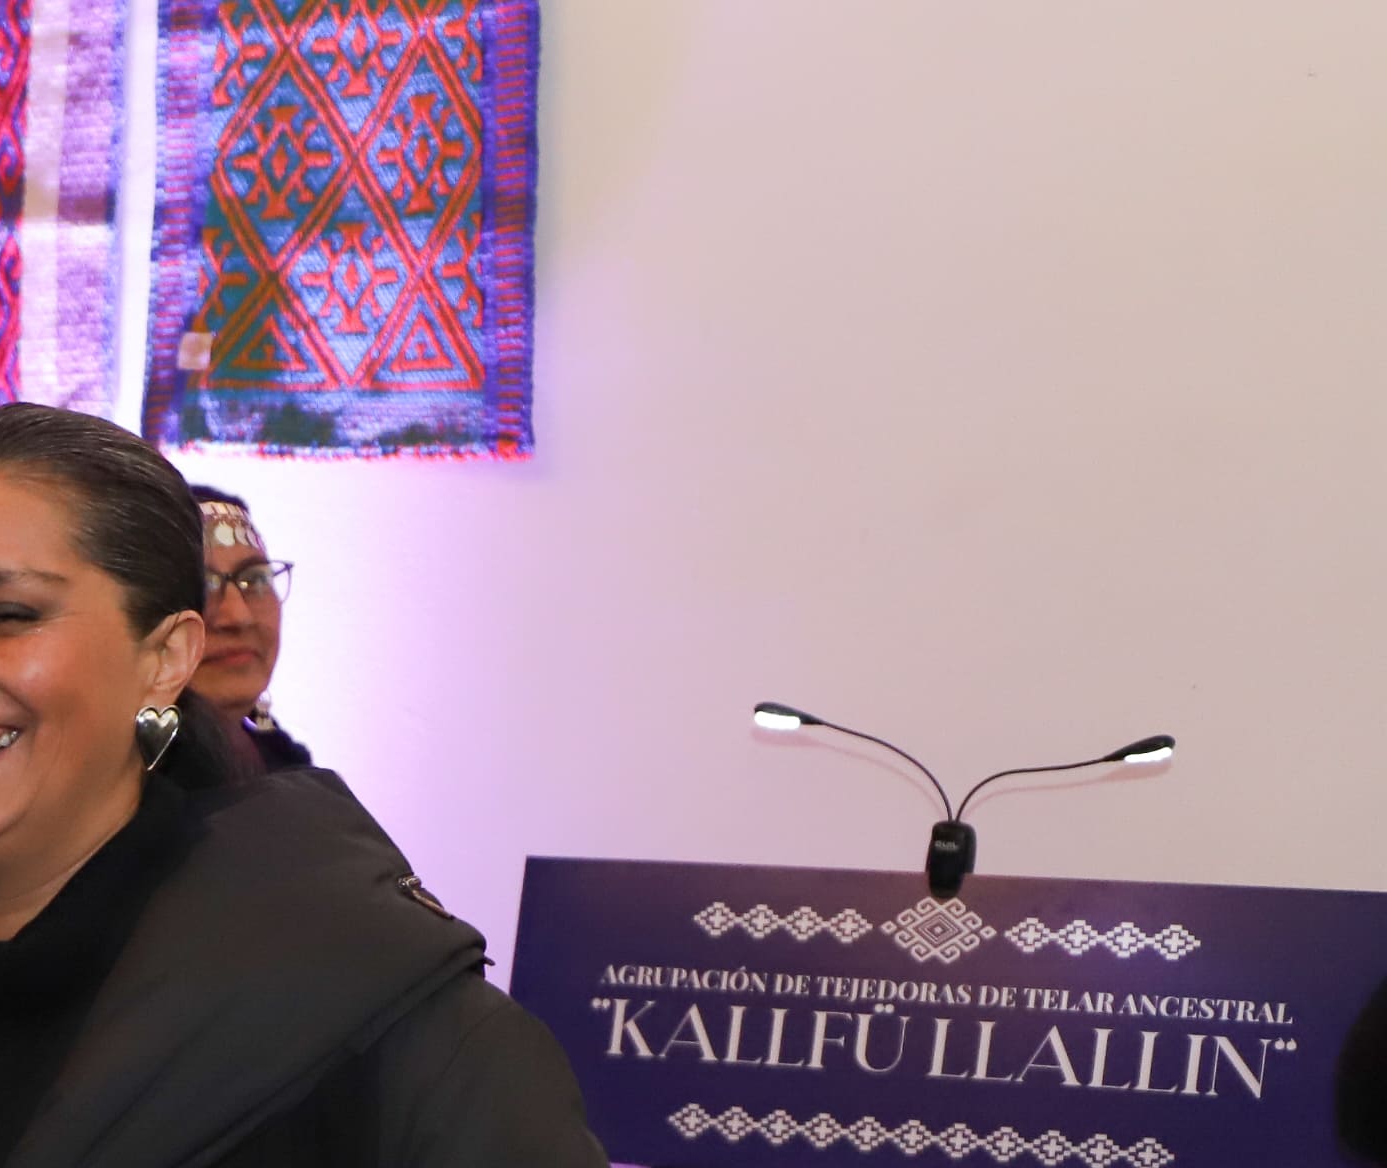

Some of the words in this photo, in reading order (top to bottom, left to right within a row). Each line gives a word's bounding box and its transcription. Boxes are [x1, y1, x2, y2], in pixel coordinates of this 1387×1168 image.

[600, 964, 768, 993] AGRUPACIÓN
[773, 973, 813, 996] DE
[817, 975, 972, 1005] TEJEDORAS
[978, 984, 1018, 1007] DE
[1023, 987, 1116, 1014] TELAR
[1118, 993, 1294, 1024] ANCESTRAL
